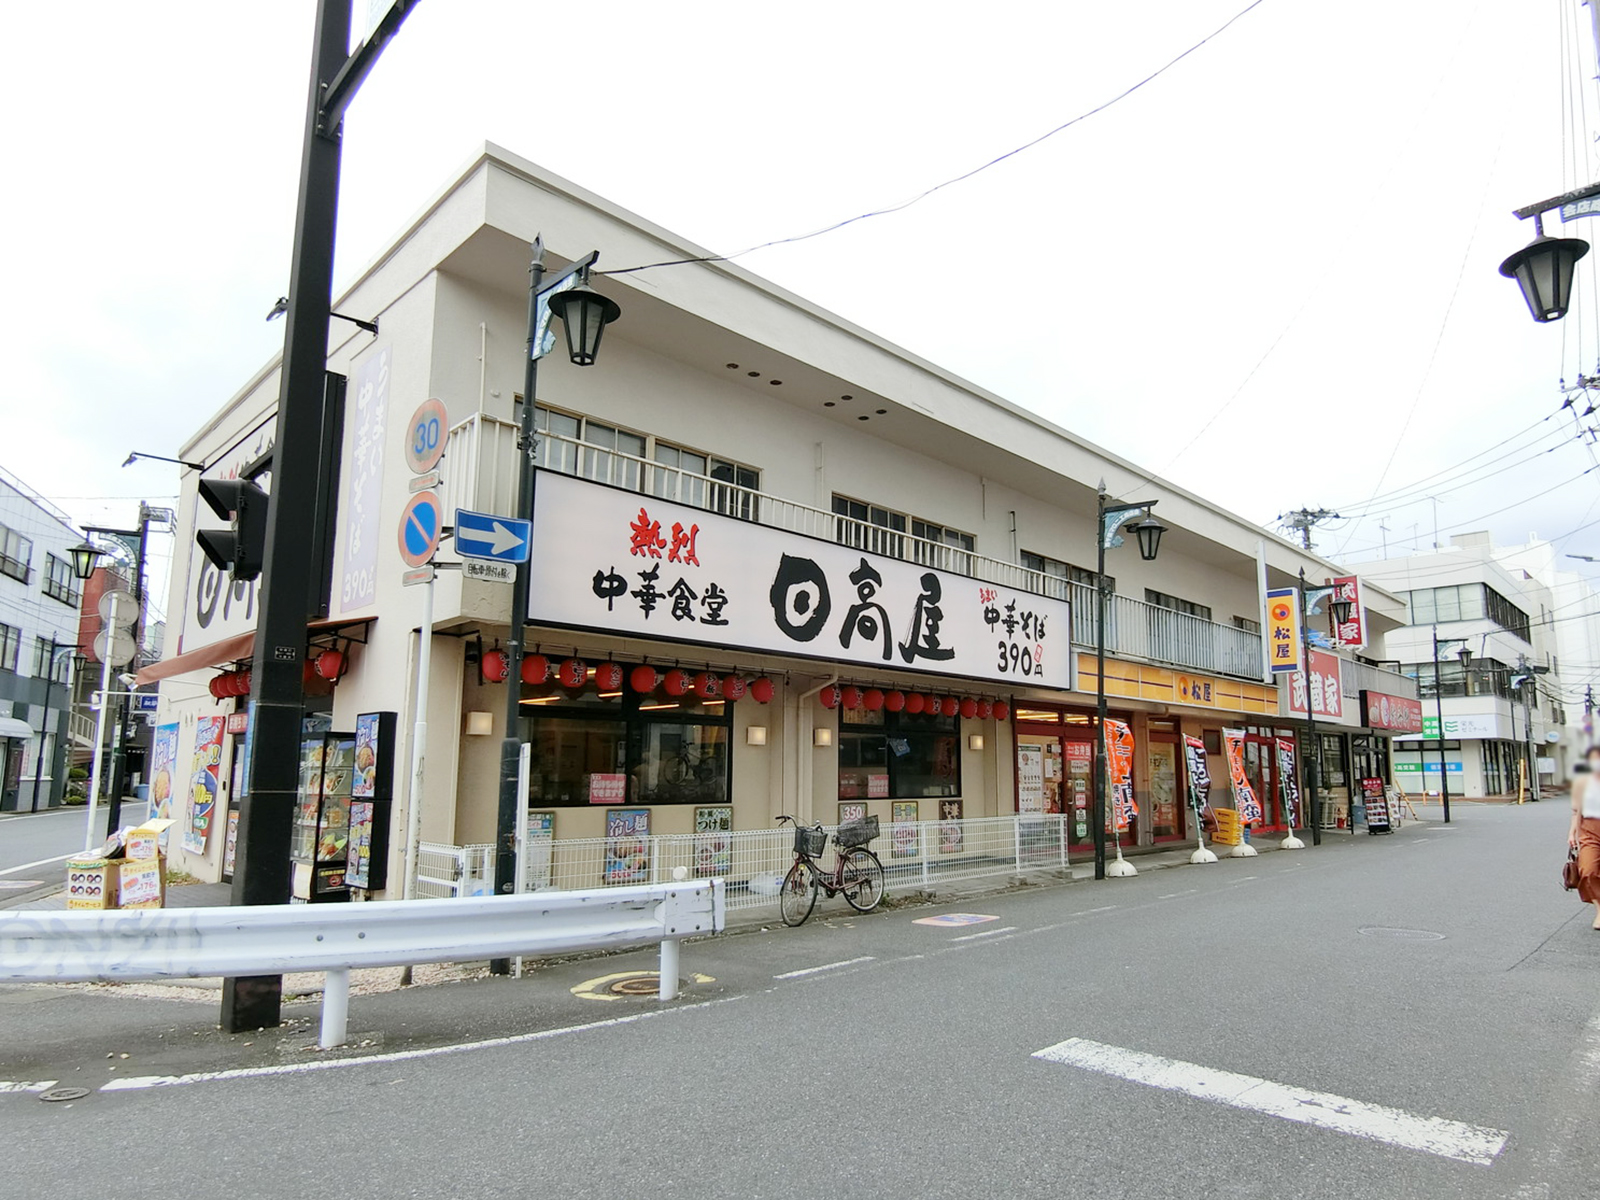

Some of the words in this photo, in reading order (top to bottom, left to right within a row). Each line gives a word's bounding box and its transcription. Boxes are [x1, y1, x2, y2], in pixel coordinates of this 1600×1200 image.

[414, 417, 440, 454] 30
[629, 507, 701, 567] 熱烈
[592, 562, 730, 627] 中華食堂
[769, 552, 955, 664] 日高屋
[983, 598, 1048, 643] 中華そば
[1273, 625, 1291, 659] 松屋
[1190, 680, 1212, 703] 松屋
[609, 814, 649, 837] 冷し麺
[697, 817, 729, 831] つけ麺
